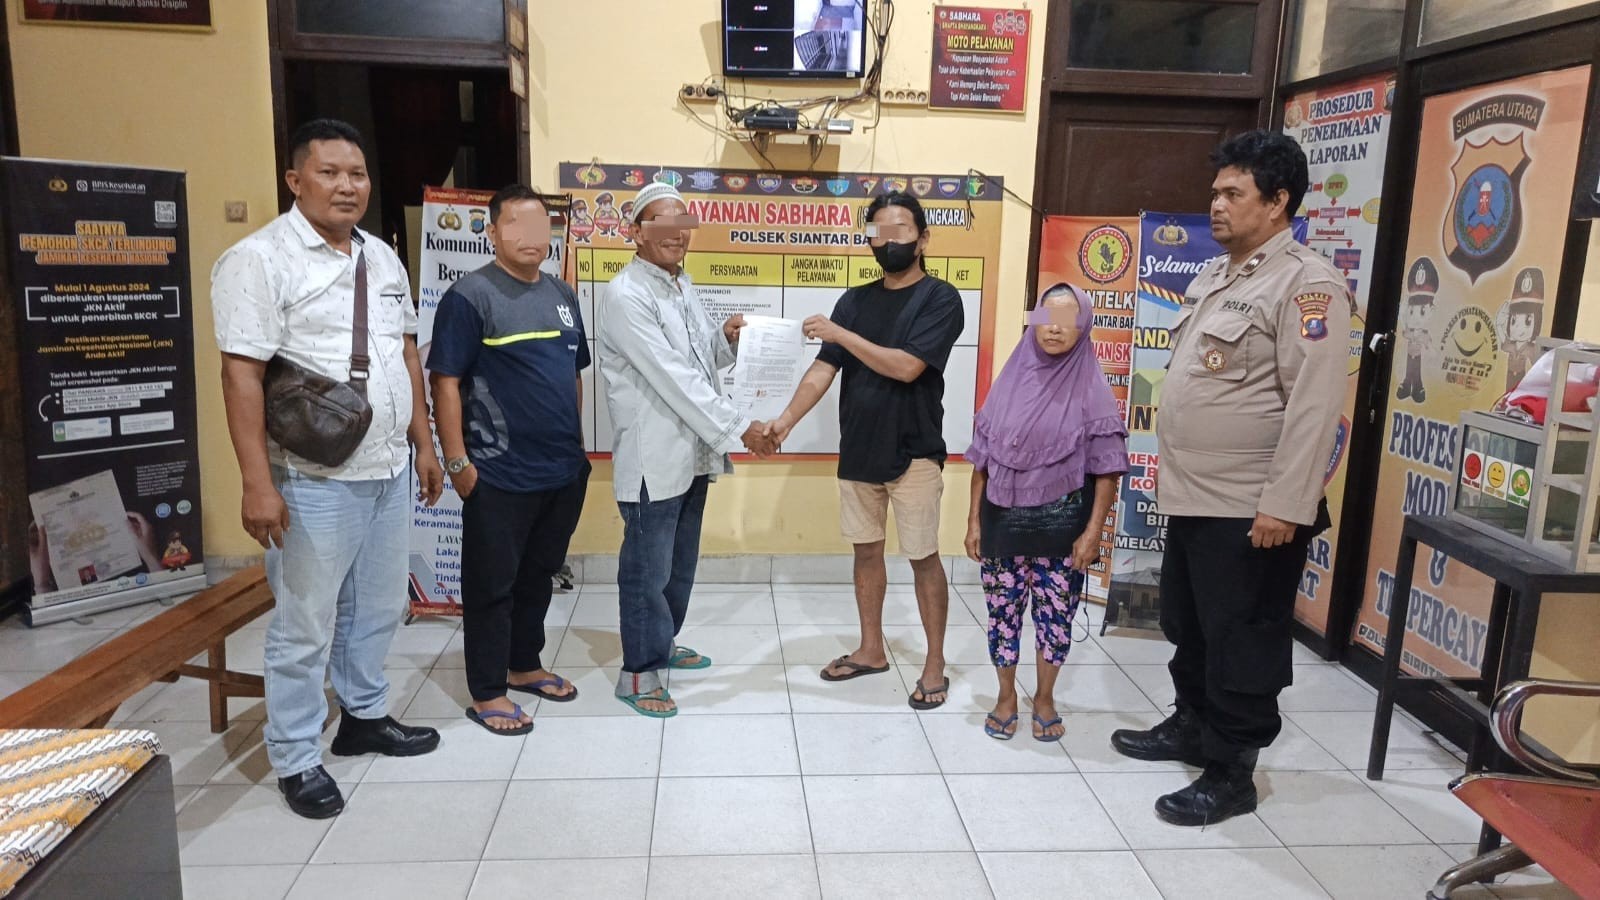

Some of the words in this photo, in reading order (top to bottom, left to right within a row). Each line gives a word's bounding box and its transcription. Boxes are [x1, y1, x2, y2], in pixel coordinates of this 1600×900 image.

[950, 11, 981, 21] SABHARA
[947, 34, 969, 49] MOTO
[970, 35, 1014, 50] PELAYANAN
[1309, 89, 1374, 119] PROSEDUR
[1456, 103, 1505, 133] SUMATERA
[1507, 103, 1538, 123] UTARA
[1300, 115, 1383, 145] PENERIMAAN
[1309, 142, 1369, 166] LAPORAN
[765, 201, 852, 226] SABHARA
[77, 223, 125, 236] SAATNYA
[22, 236, 78, 250] PEMOHON
[81, 238, 111, 251] SKCK
[730, 230, 785, 243] POLSEK
[790, 232, 849, 245] SIANTAR
[80, 252, 128, 264] KESEHATAN
[791, 258, 819, 271] JANGKA
[820, 259, 844, 271] WAKTU
[579, 261, 590, 272] NO
[710, 264, 758, 277] PERSYARATAN
[956, 269, 970, 281] KET
[797, 271, 836, 283] PELAYANAN
[55, 283, 82, 293] Mulai
[83, 284, 87, 292] 1
[89, 283, 127, 294] Agustus
[128, 283, 150, 292] 2024
[422, 288, 434, 297] WA
[40, 294, 106, 304] diberlakukan
[106, 293, 164, 303] kepesertaan
[84, 303, 103, 312] JKN
[104, 303, 126, 312] Aktif
[1222, 300, 1253, 314] POLRI
[51, 313, 80, 323] untuk
[81, 312, 133, 324] penerbitan
[134, 311, 158, 321] SKCK
[64, 335, 100, 344] Pastikan
[101, 333, 150, 344] Kepesertaan
[37, 344, 75, 354] Jaminan
[75, 342, 118, 352] Kesehatan
[118, 340, 152, 350] Nasional
[153, 338, 174, 349] (JKN)
[85, 351, 106, 360] Anda
[107, 350, 126, 359] Aktif
[436, 547, 459, 557] Laka
